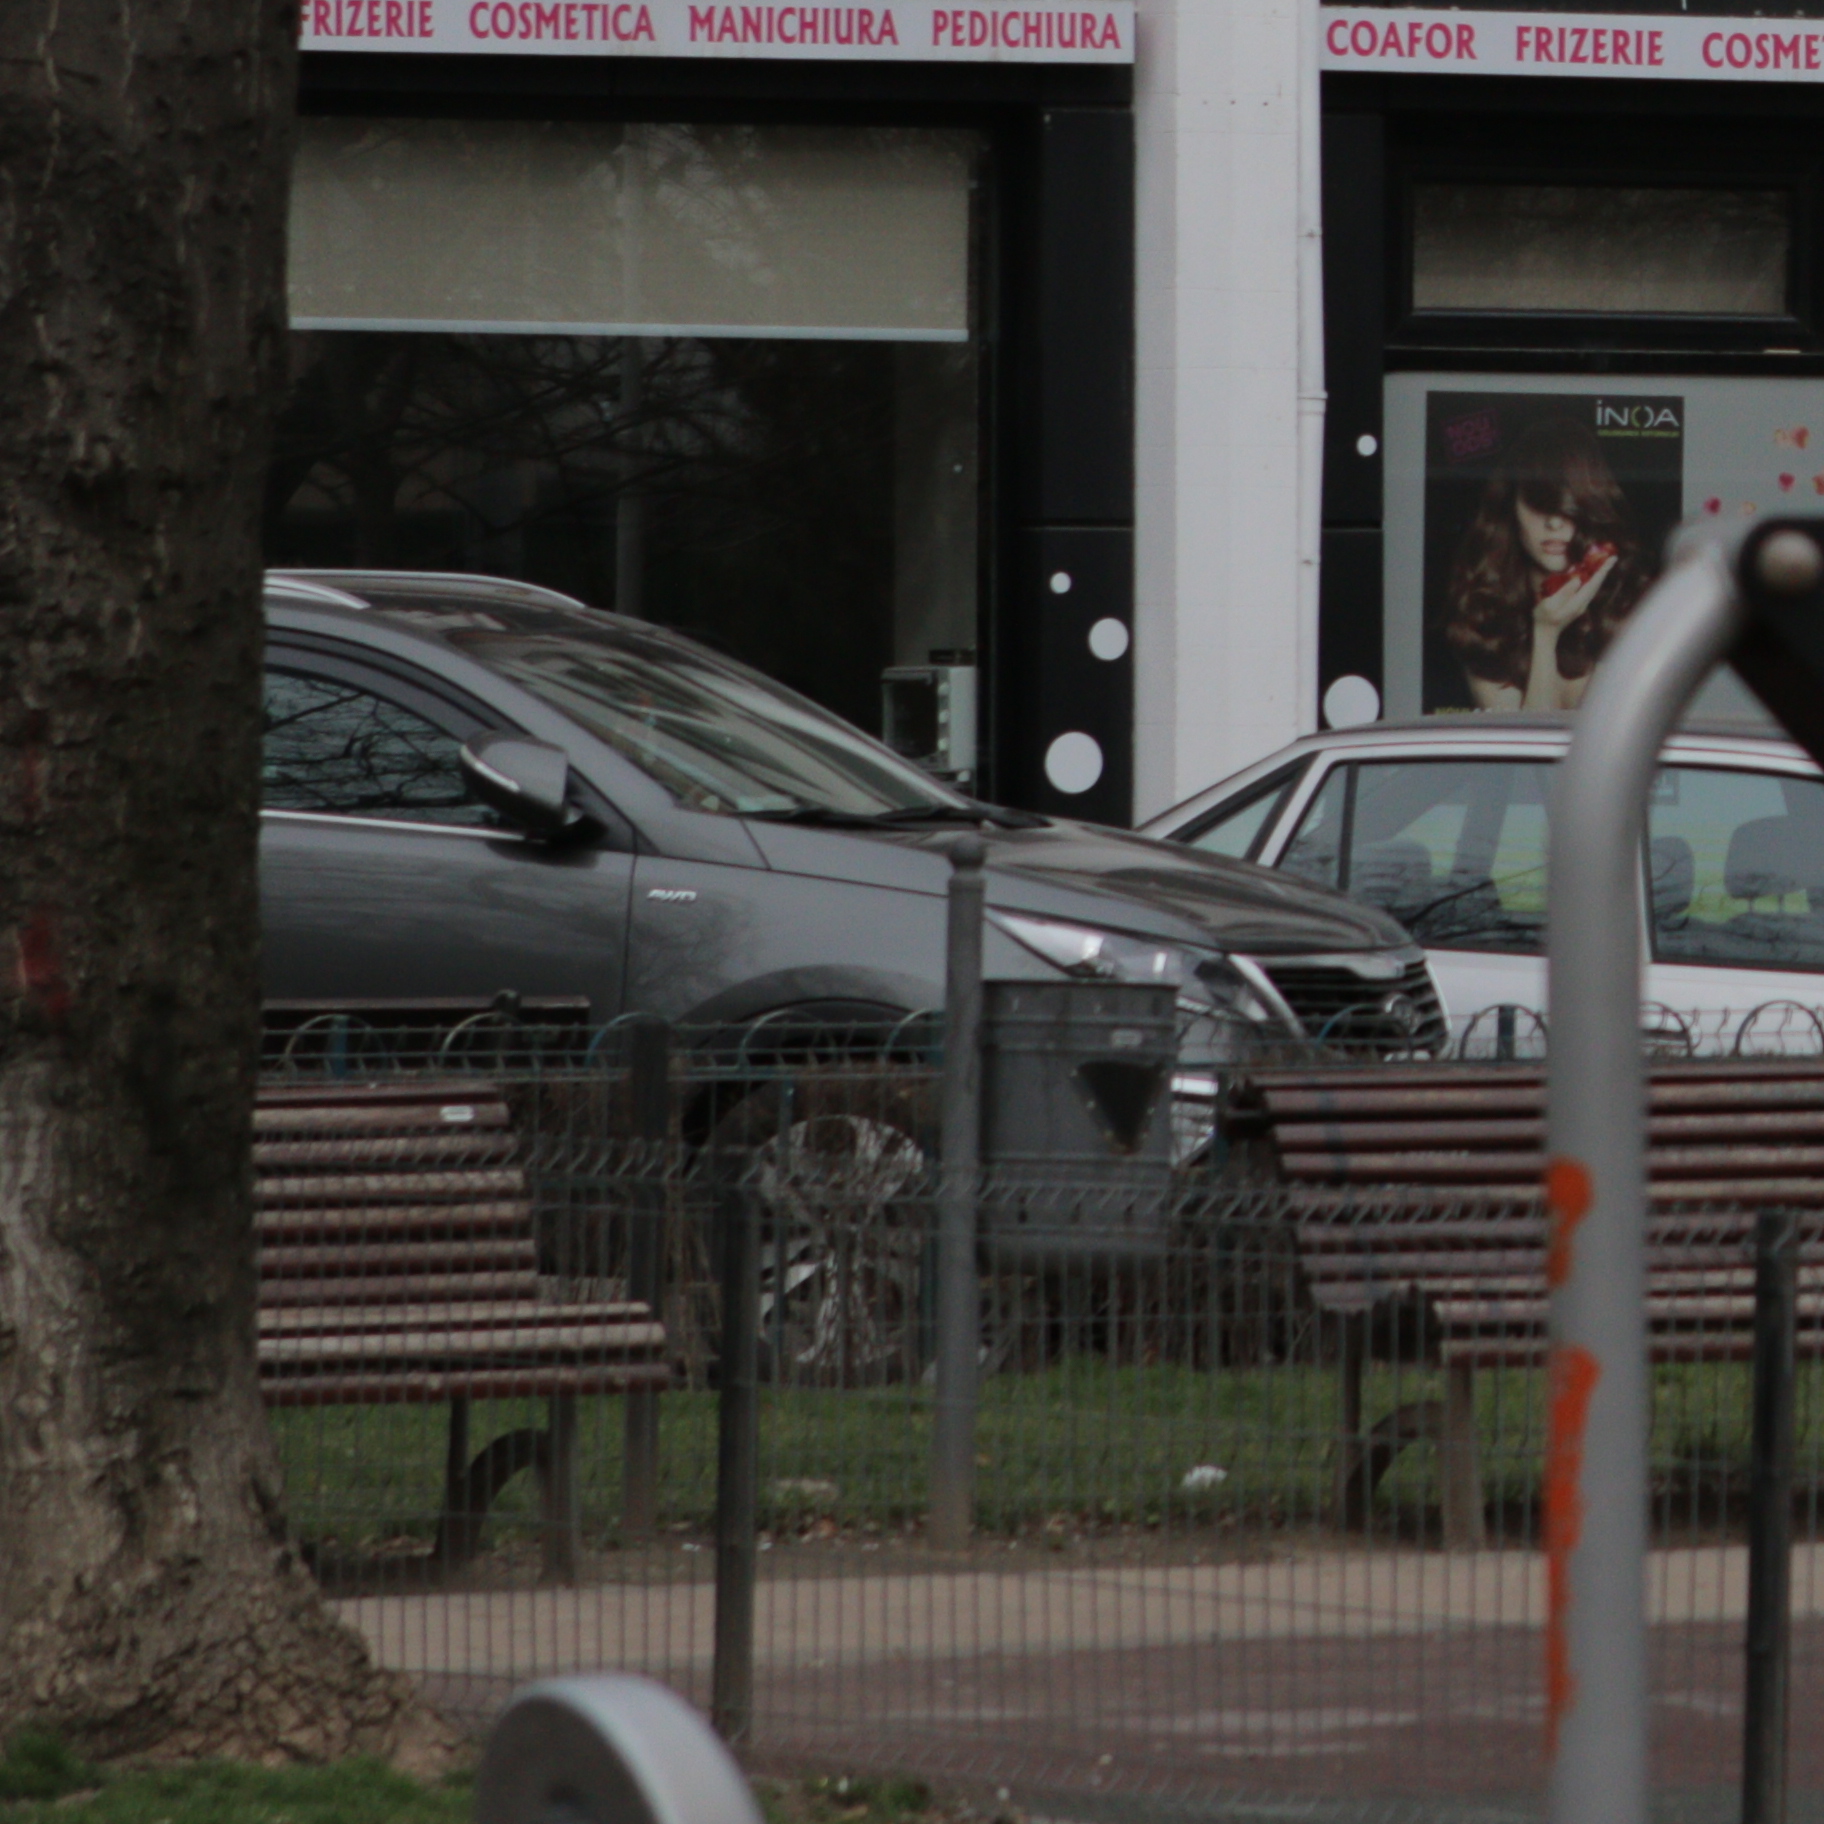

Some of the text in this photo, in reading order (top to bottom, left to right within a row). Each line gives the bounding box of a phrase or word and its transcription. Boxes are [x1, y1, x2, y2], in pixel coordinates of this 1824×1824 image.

[468, 1, 656, 42] COSMETICA
[688, 5, 900, 46] MANICHIURA
[931, 9, 1122, 50] PEDICHIURA
[1325, 19, 1478, 61] COAFOR
[1515, 25, 1665, 66] FRIZERIE
